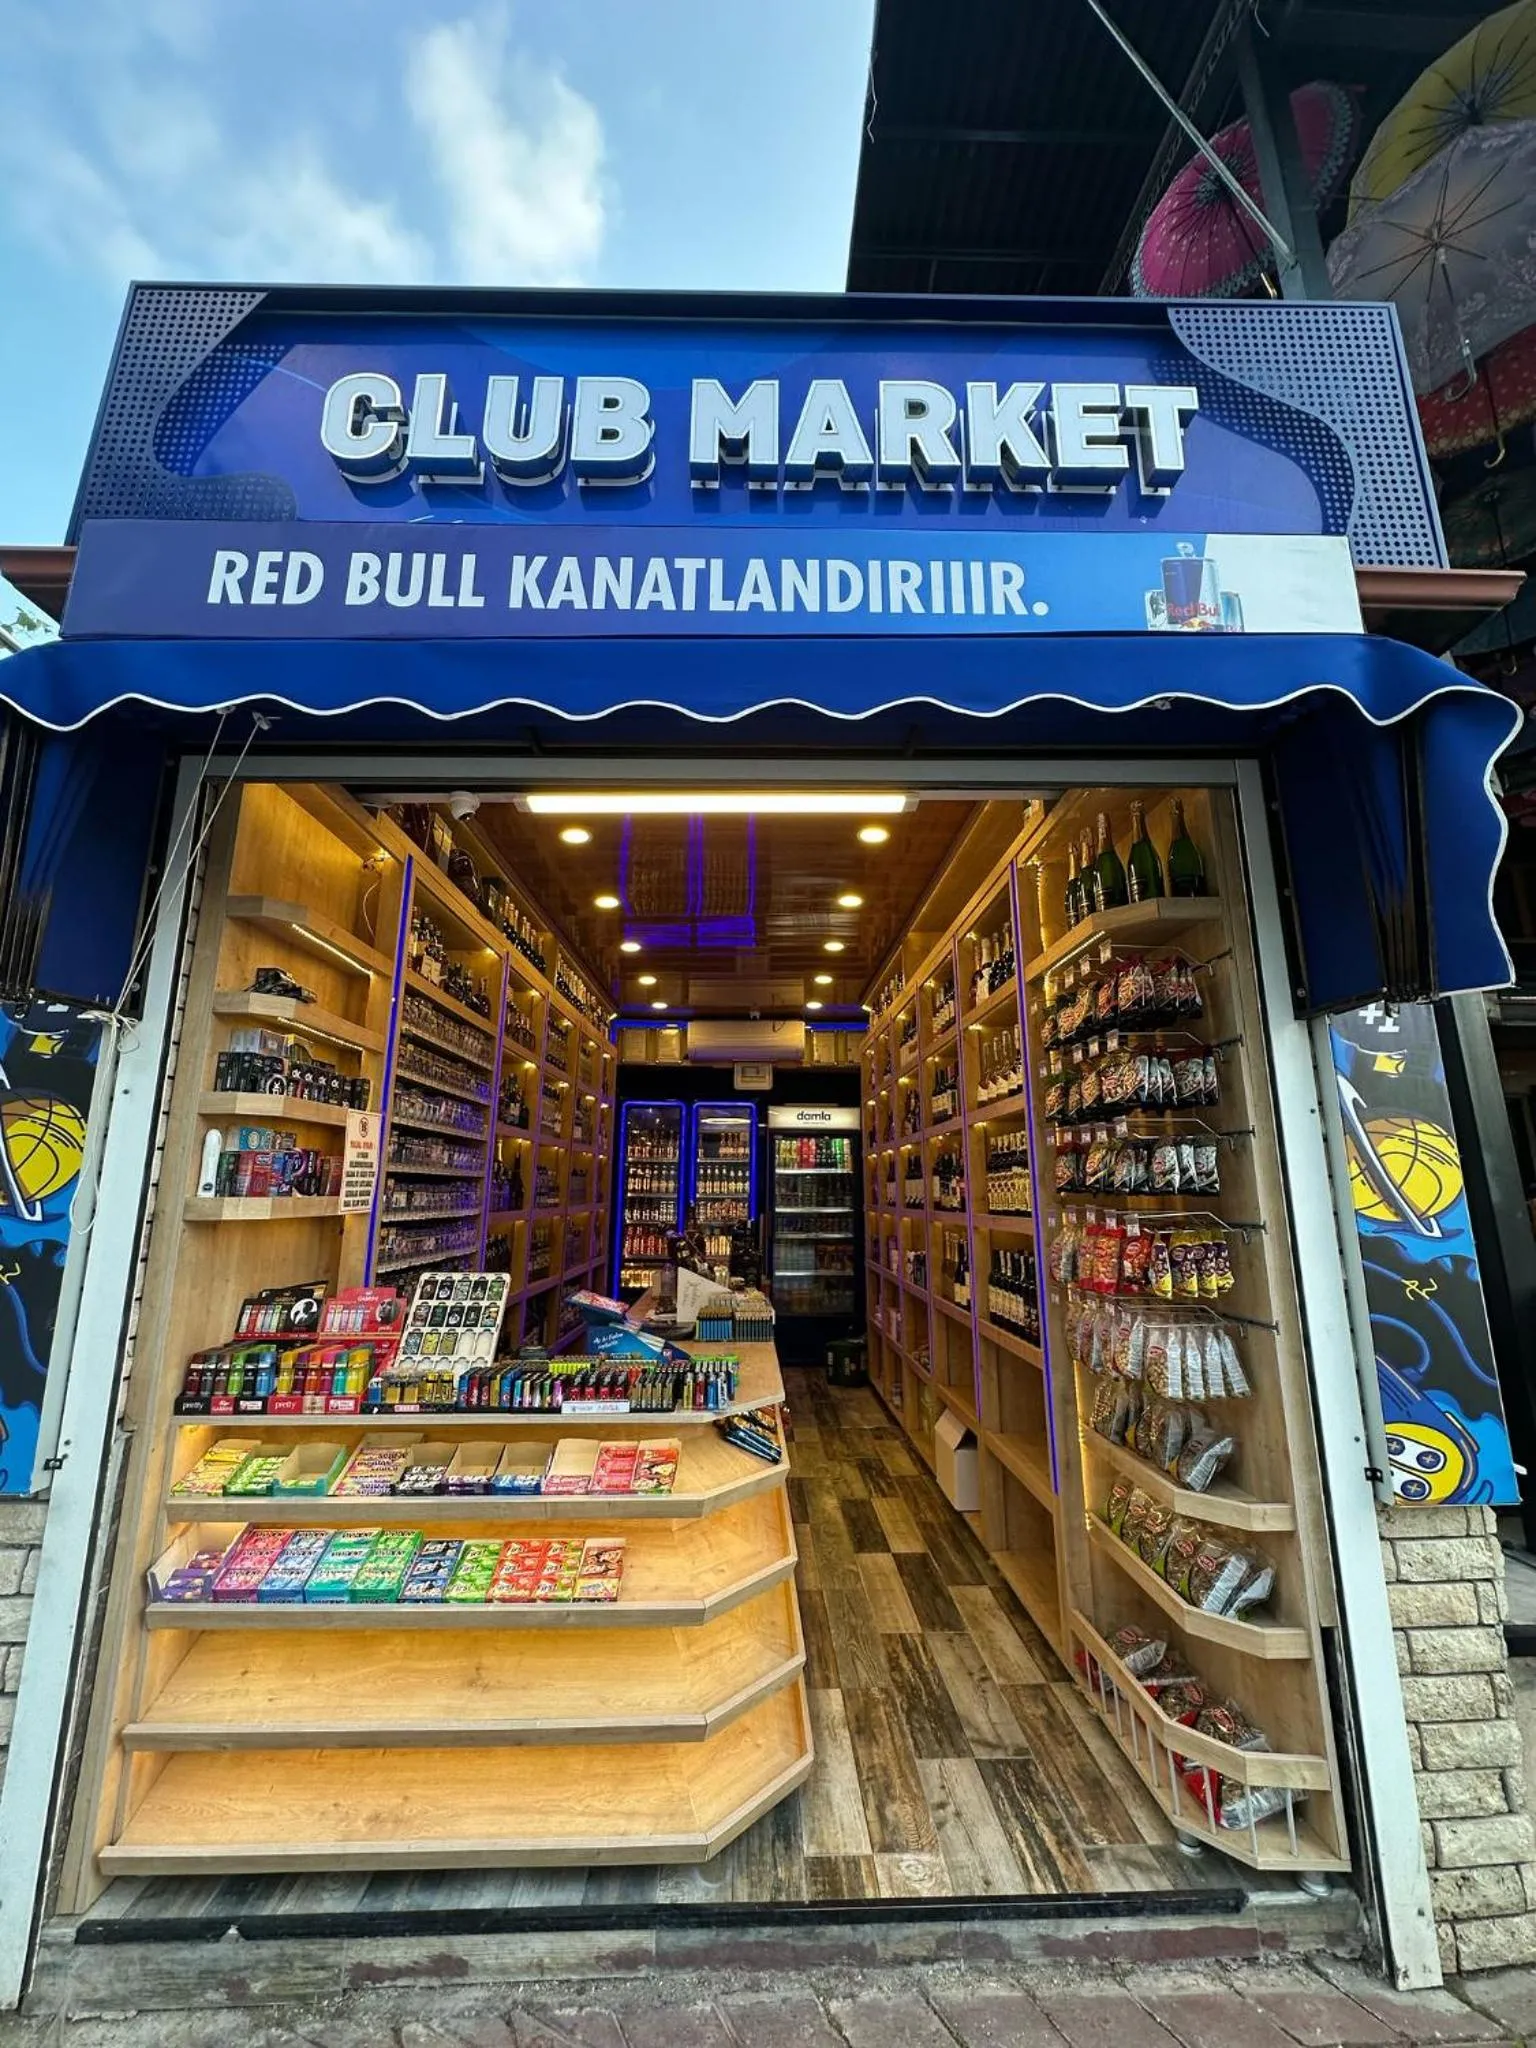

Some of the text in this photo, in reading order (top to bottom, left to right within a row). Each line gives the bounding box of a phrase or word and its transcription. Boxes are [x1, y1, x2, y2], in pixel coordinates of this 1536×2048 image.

[320, 372, 1199, 490] CLUB MARKET
[206, 549, 1050, 617] RED BULL KANATLANDIRIIIR.
[796, 1110, 831, 1121] damla
